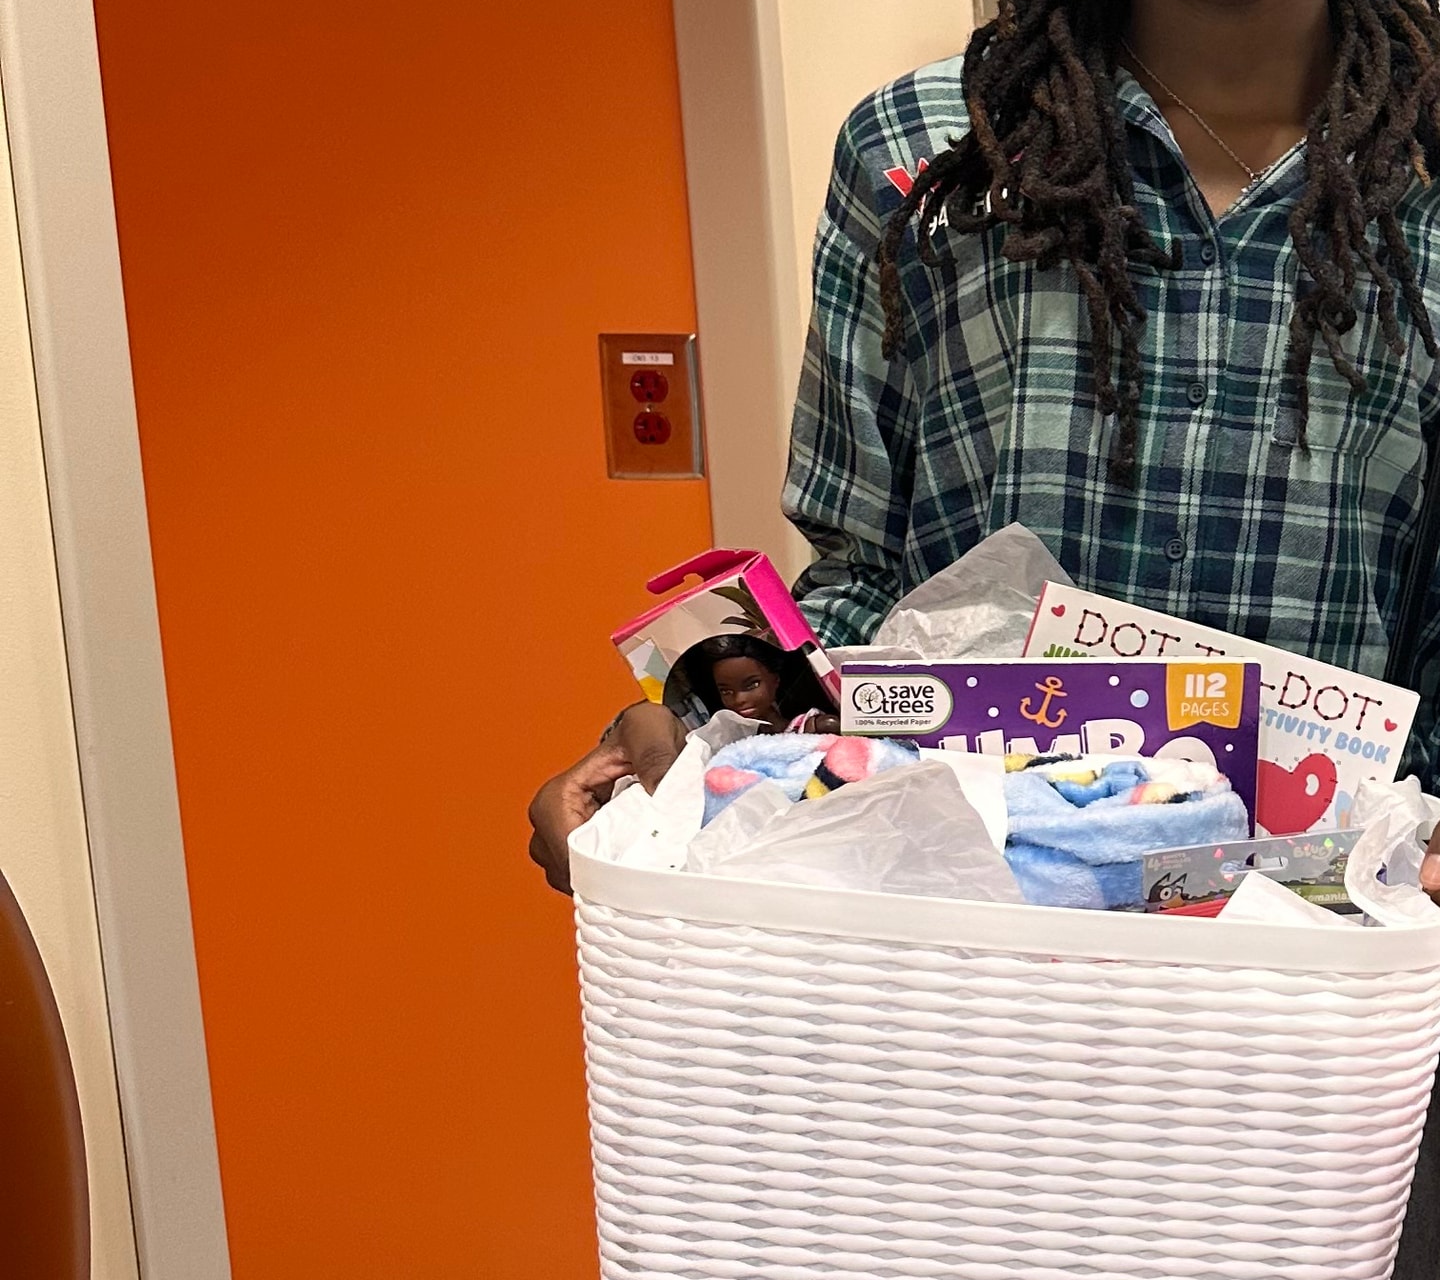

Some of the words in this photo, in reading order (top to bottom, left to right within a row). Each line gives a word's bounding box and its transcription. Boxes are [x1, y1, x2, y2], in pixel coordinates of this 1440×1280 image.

[888, 685, 935, 699] save
[1185, 672, 1227, 698] 112
[882, 697, 935, 713] trees
[1180, 701, 1230, 717] PAGES
[876, 718, 909, 726] Recycled
[911, 718, 932, 726] Paper
[1260, 705, 1332, 745] TIVITY
[1334, 731, 1391, 765] BOOK
